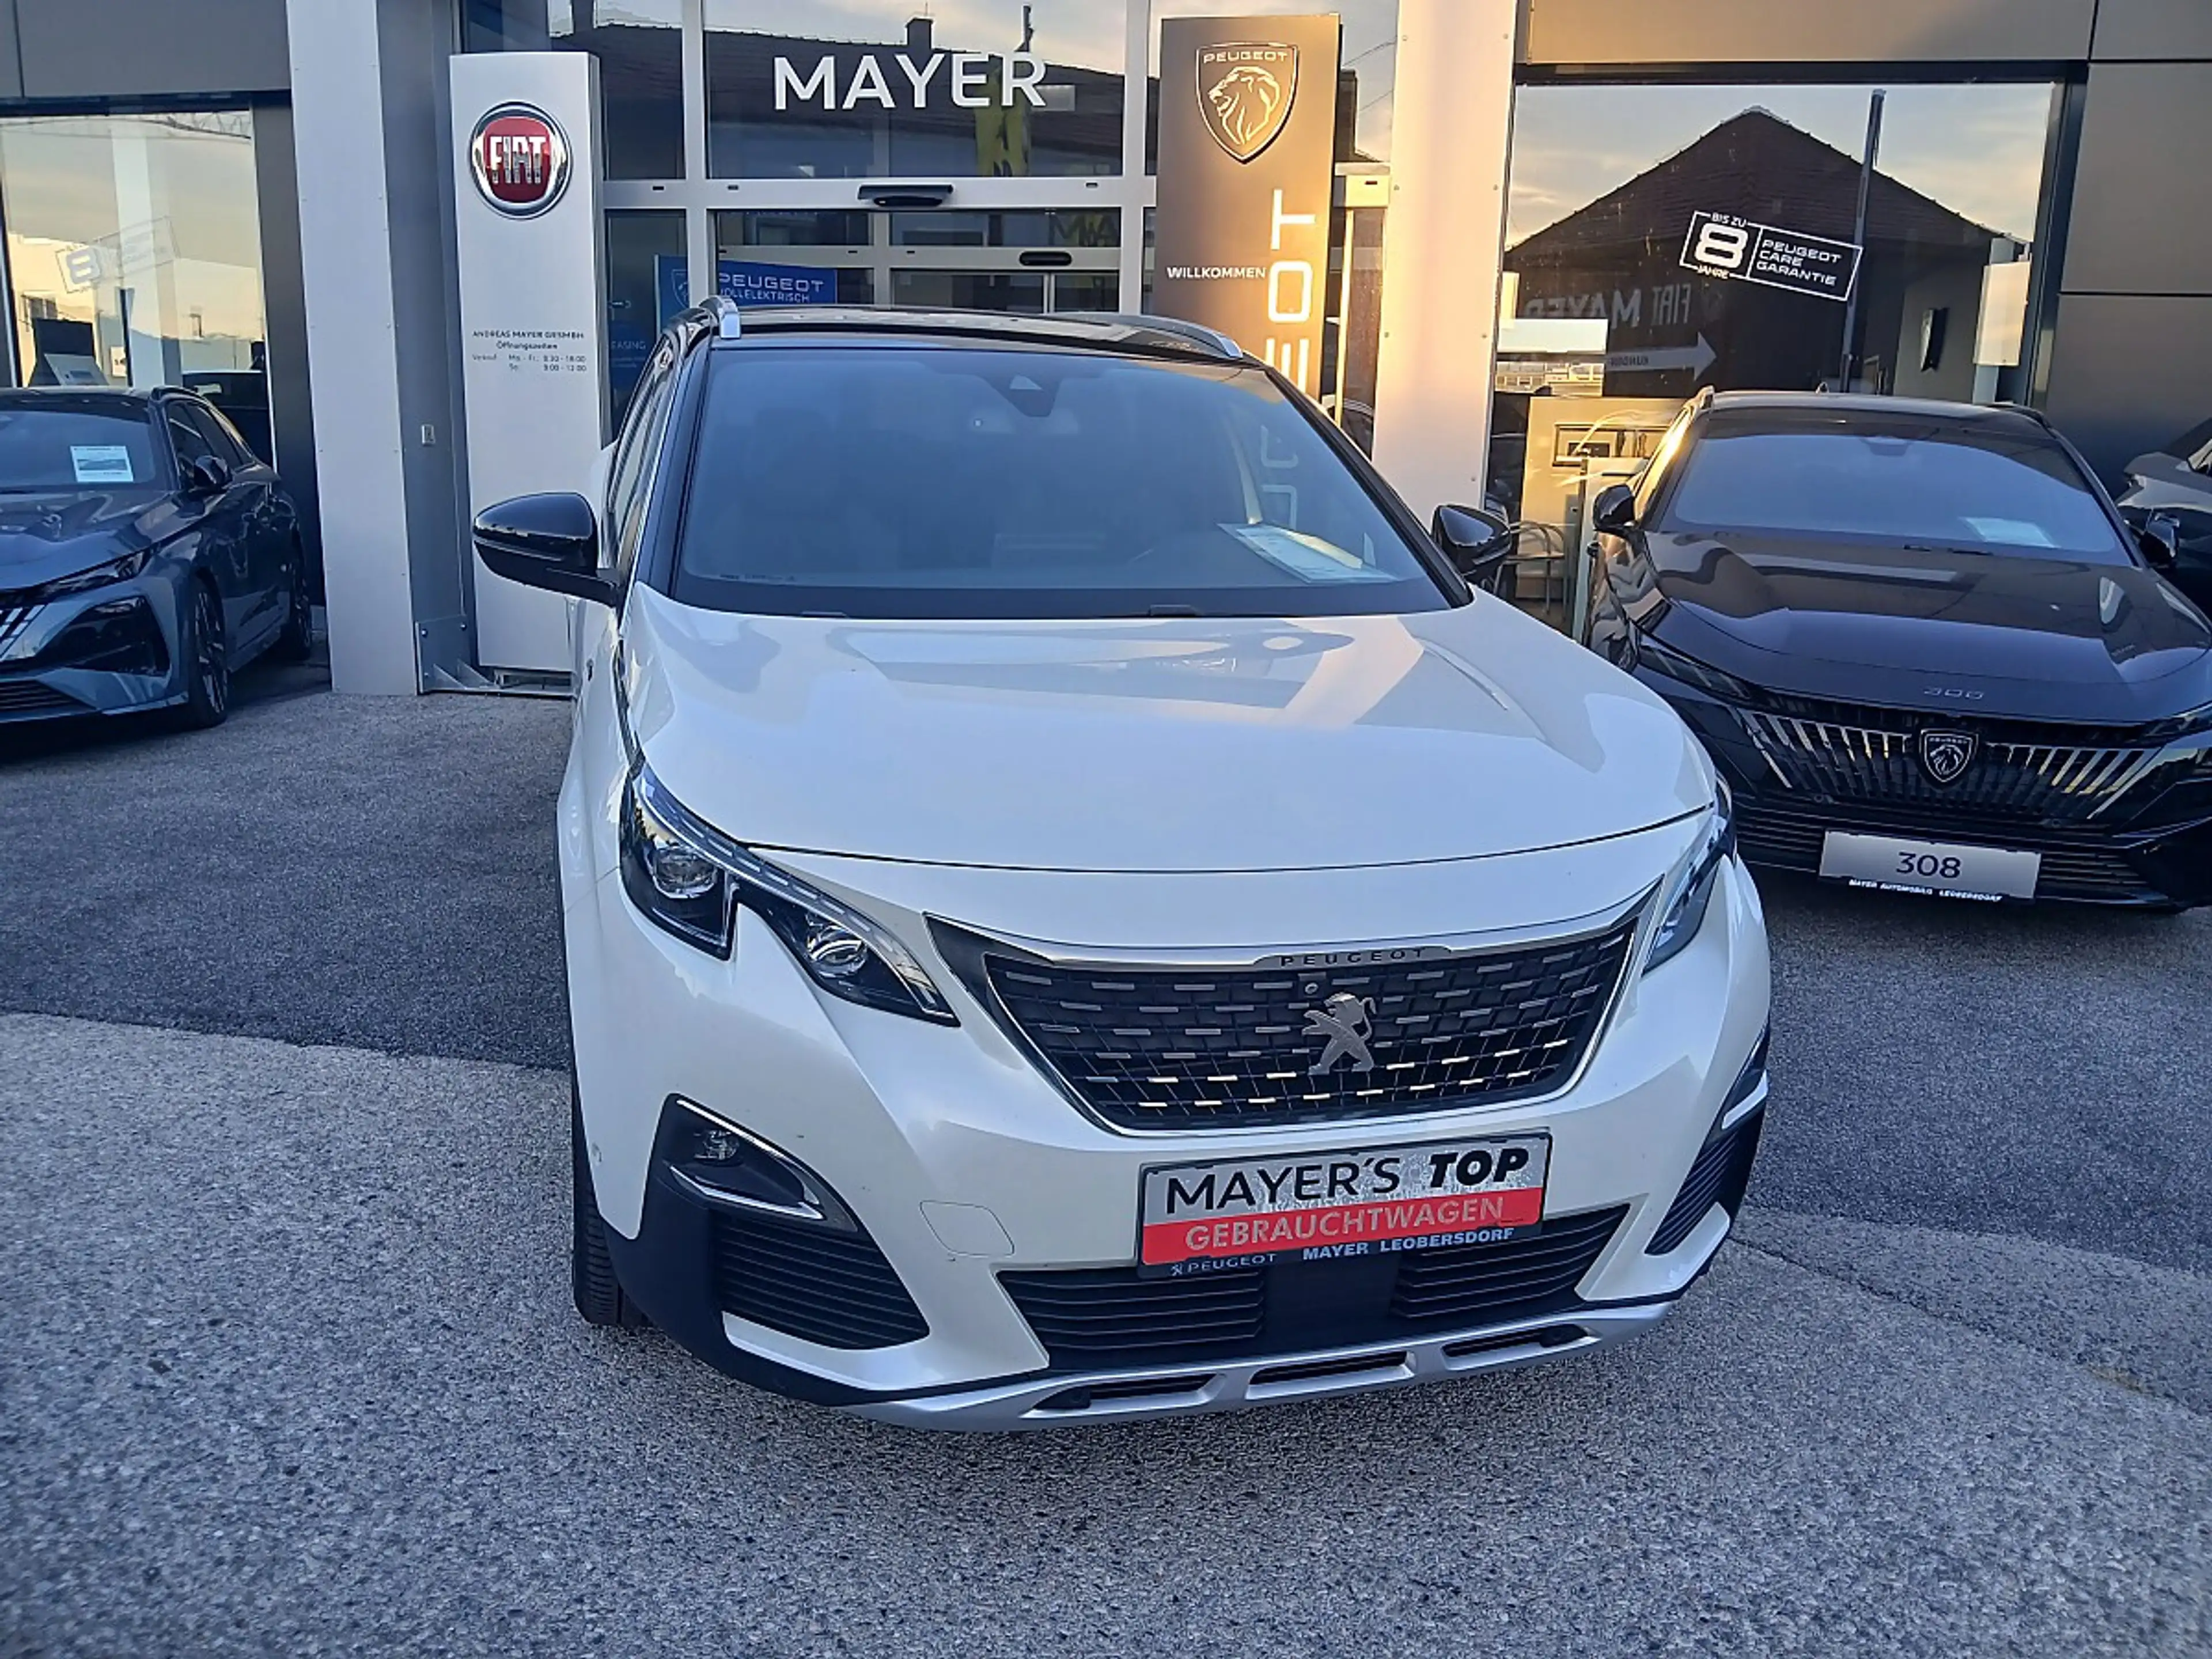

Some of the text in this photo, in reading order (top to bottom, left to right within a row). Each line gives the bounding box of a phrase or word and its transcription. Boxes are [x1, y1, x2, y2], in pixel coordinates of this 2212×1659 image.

[1203, 51, 1287, 63] PEUGEOT
[774, 53, 1047, 111] MAYER
[490, 135, 547, 184] FIAT
[1711, 212, 1747, 228] BIS ZU
[1695, 222, 1748, 269] 8
[1762, 240, 1842, 263] PEUGEOT
[1759, 250, 1803, 267] CARE
[718, 272, 824, 292] PEUGEOT
[1166, 266, 1267, 279] WILLKOMMEN
[1697, 265, 1730, 279] JAHRE
[1756, 262, 1838, 286] GARANTIE
[512, 330, 543, 339] MAYER
[1896, 851, 1962, 879] 308
[1279, 949, 1426, 967] PEUGEOT
[1166, 1147, 1531, 1214] MAYER'S TOP
[1185, 1196, 1505, 1251] GEBRAUCHTWAGEN
[1188, 1227, 1515, 1272] PEUGEOT MAYER LEOBERSDORF
